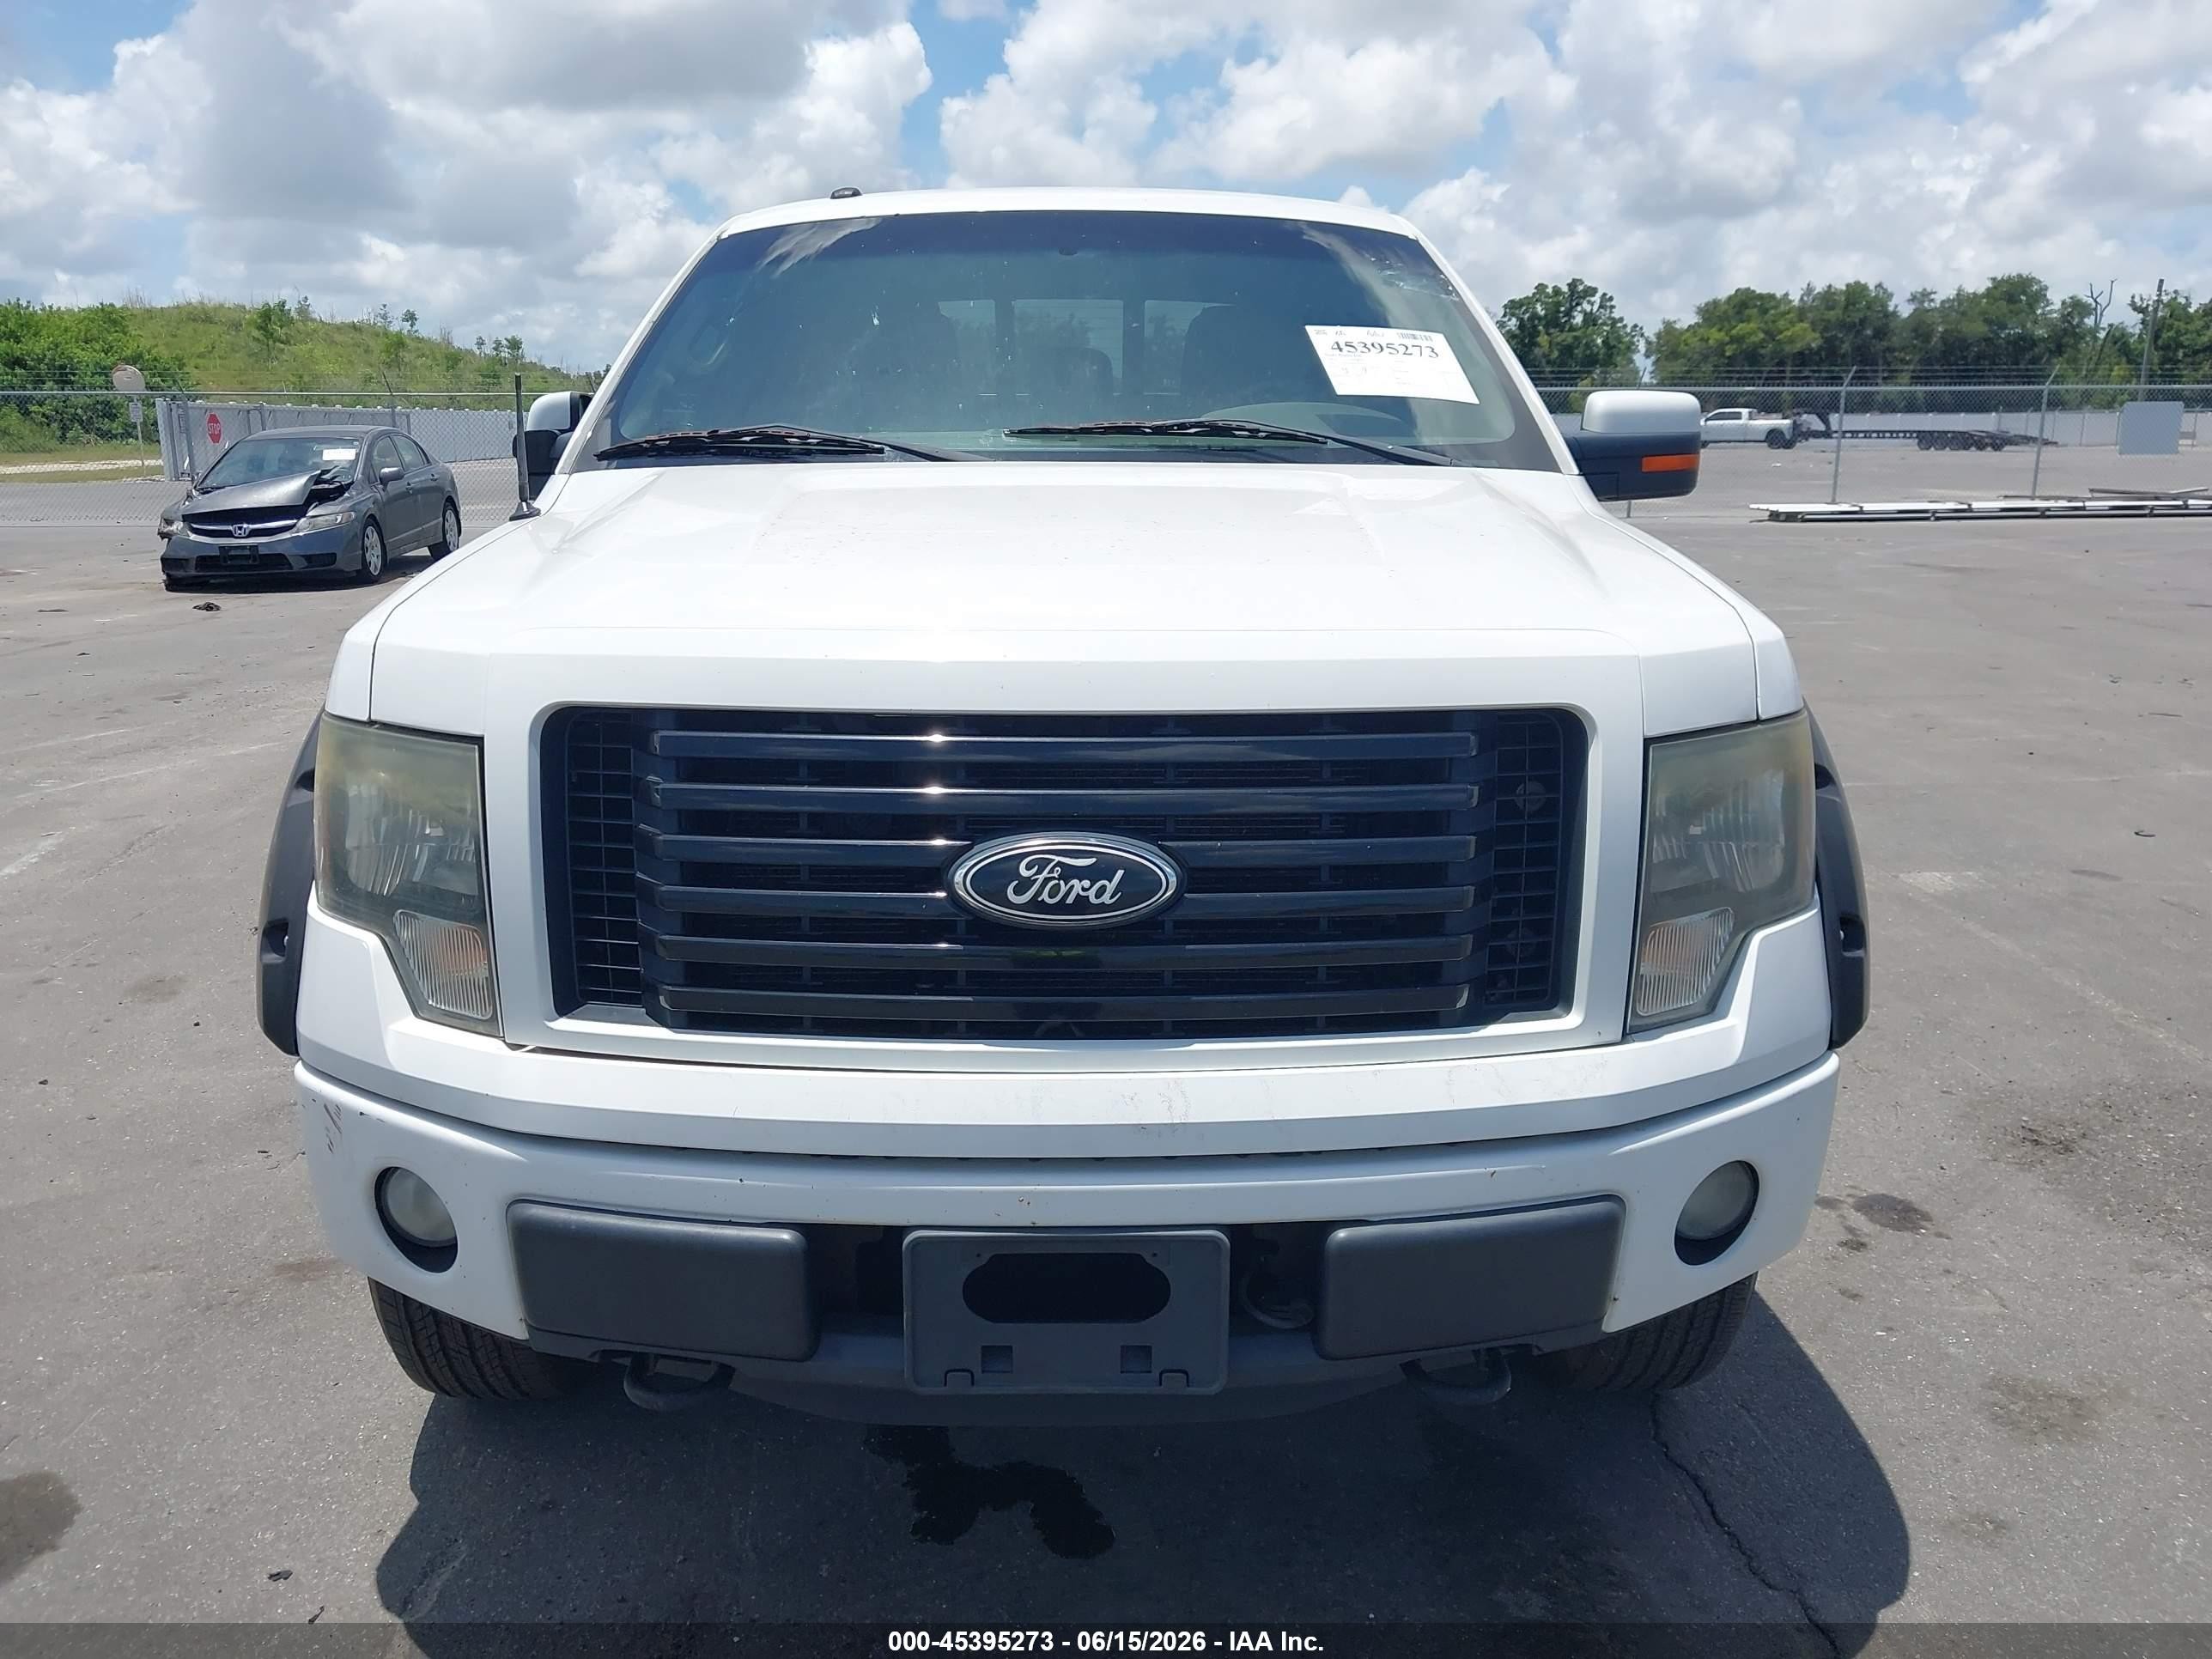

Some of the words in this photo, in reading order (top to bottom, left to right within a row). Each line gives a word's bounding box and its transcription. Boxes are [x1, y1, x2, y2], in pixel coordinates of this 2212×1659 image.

[1331, 340, 1439, 359] 45395273
[208, 422, 221, 434] STOP
[1006, 854, 1125, 904] Ford
